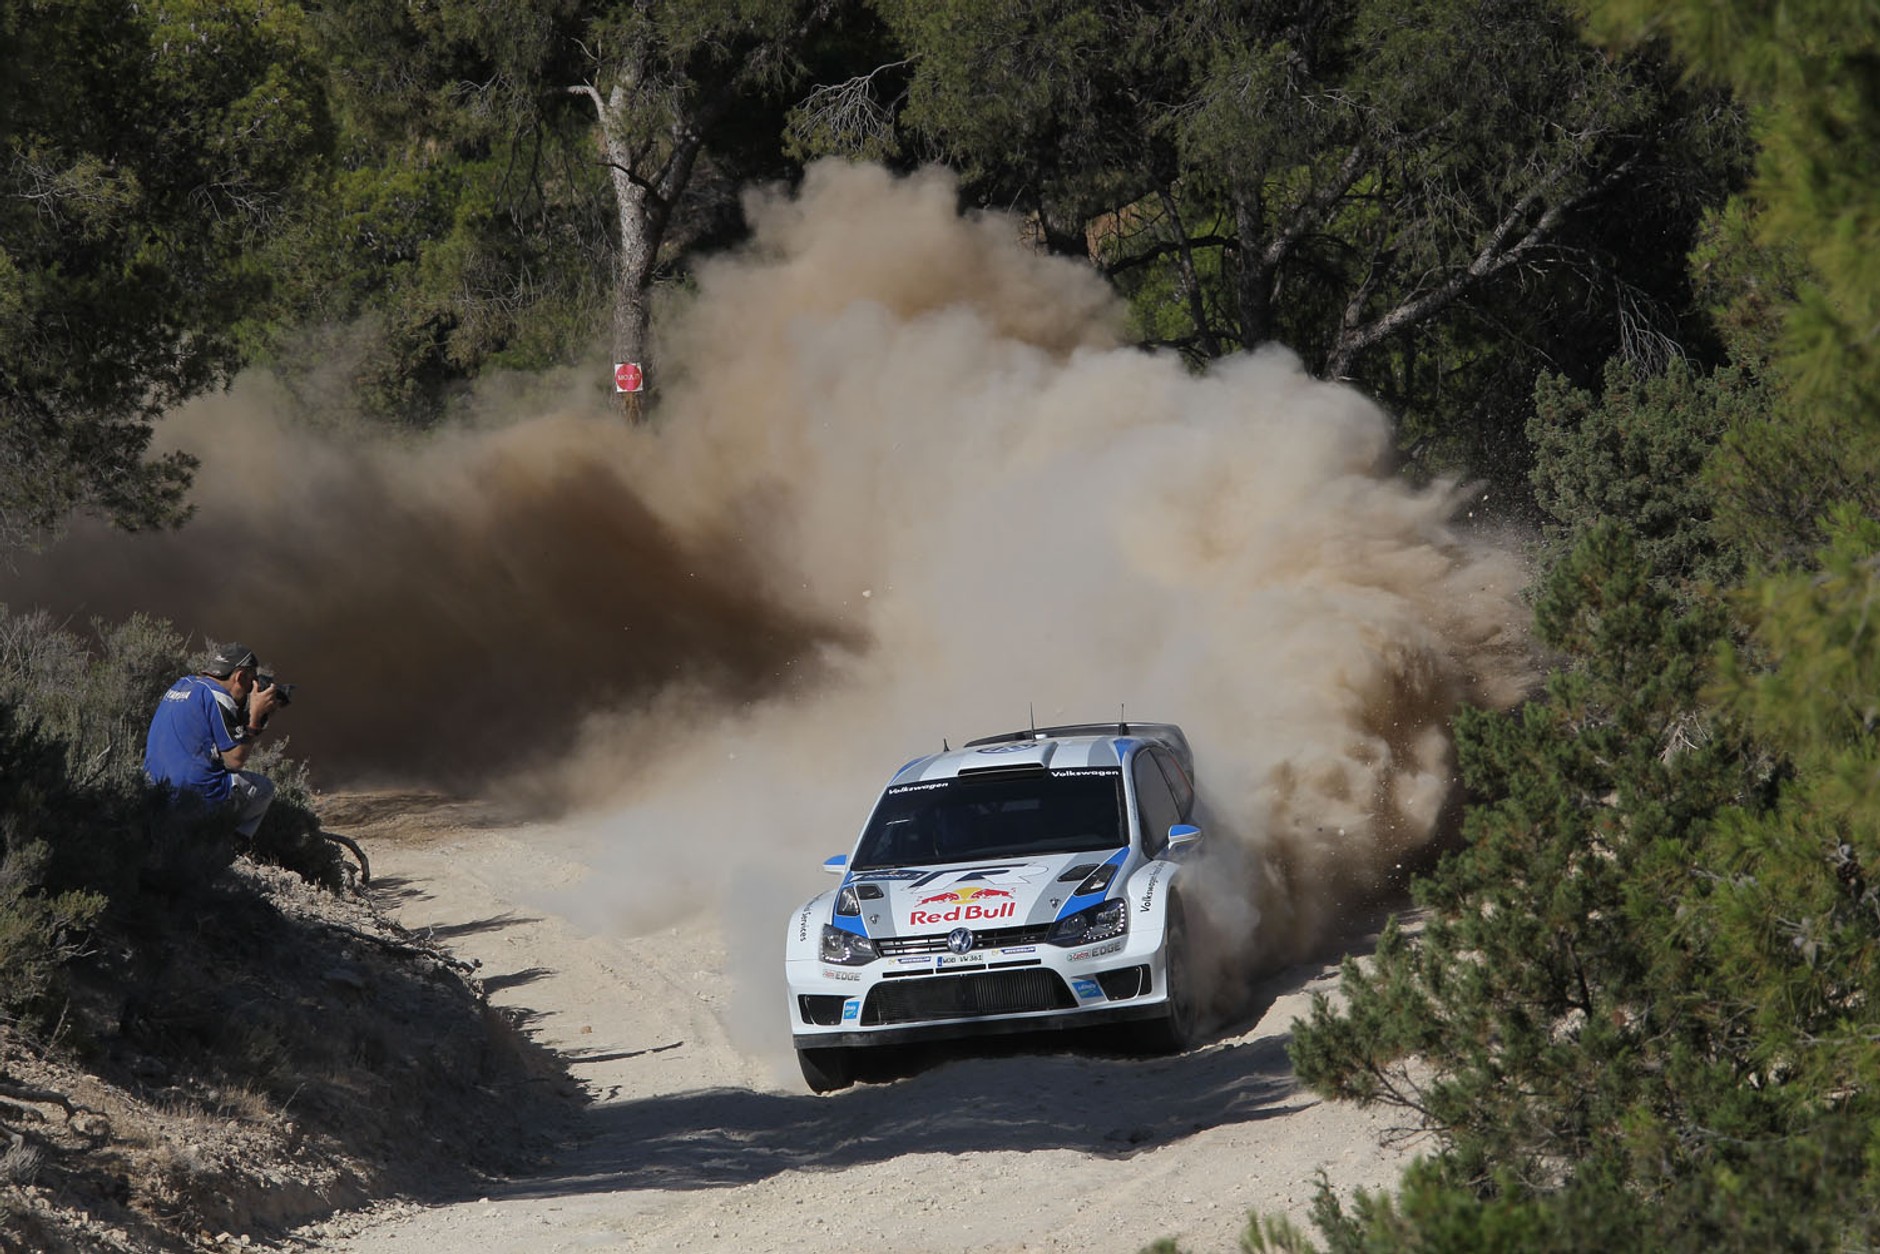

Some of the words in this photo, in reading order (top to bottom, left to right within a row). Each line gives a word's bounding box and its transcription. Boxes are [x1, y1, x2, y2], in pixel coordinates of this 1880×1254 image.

[1051, 769, 1120, 778] Volkswagen
[888, 782, 949, 795] Volkswagen
[1140, 875, 1158, 913] Volkswagen
[909, 906, 961, 926] Red
[965, 902, 1016, 920] Bull
[800, 911, 811, 942] Services
[1091, 941, 1121, 957] EDGE
[834, 970, 862, 981] EDGE
